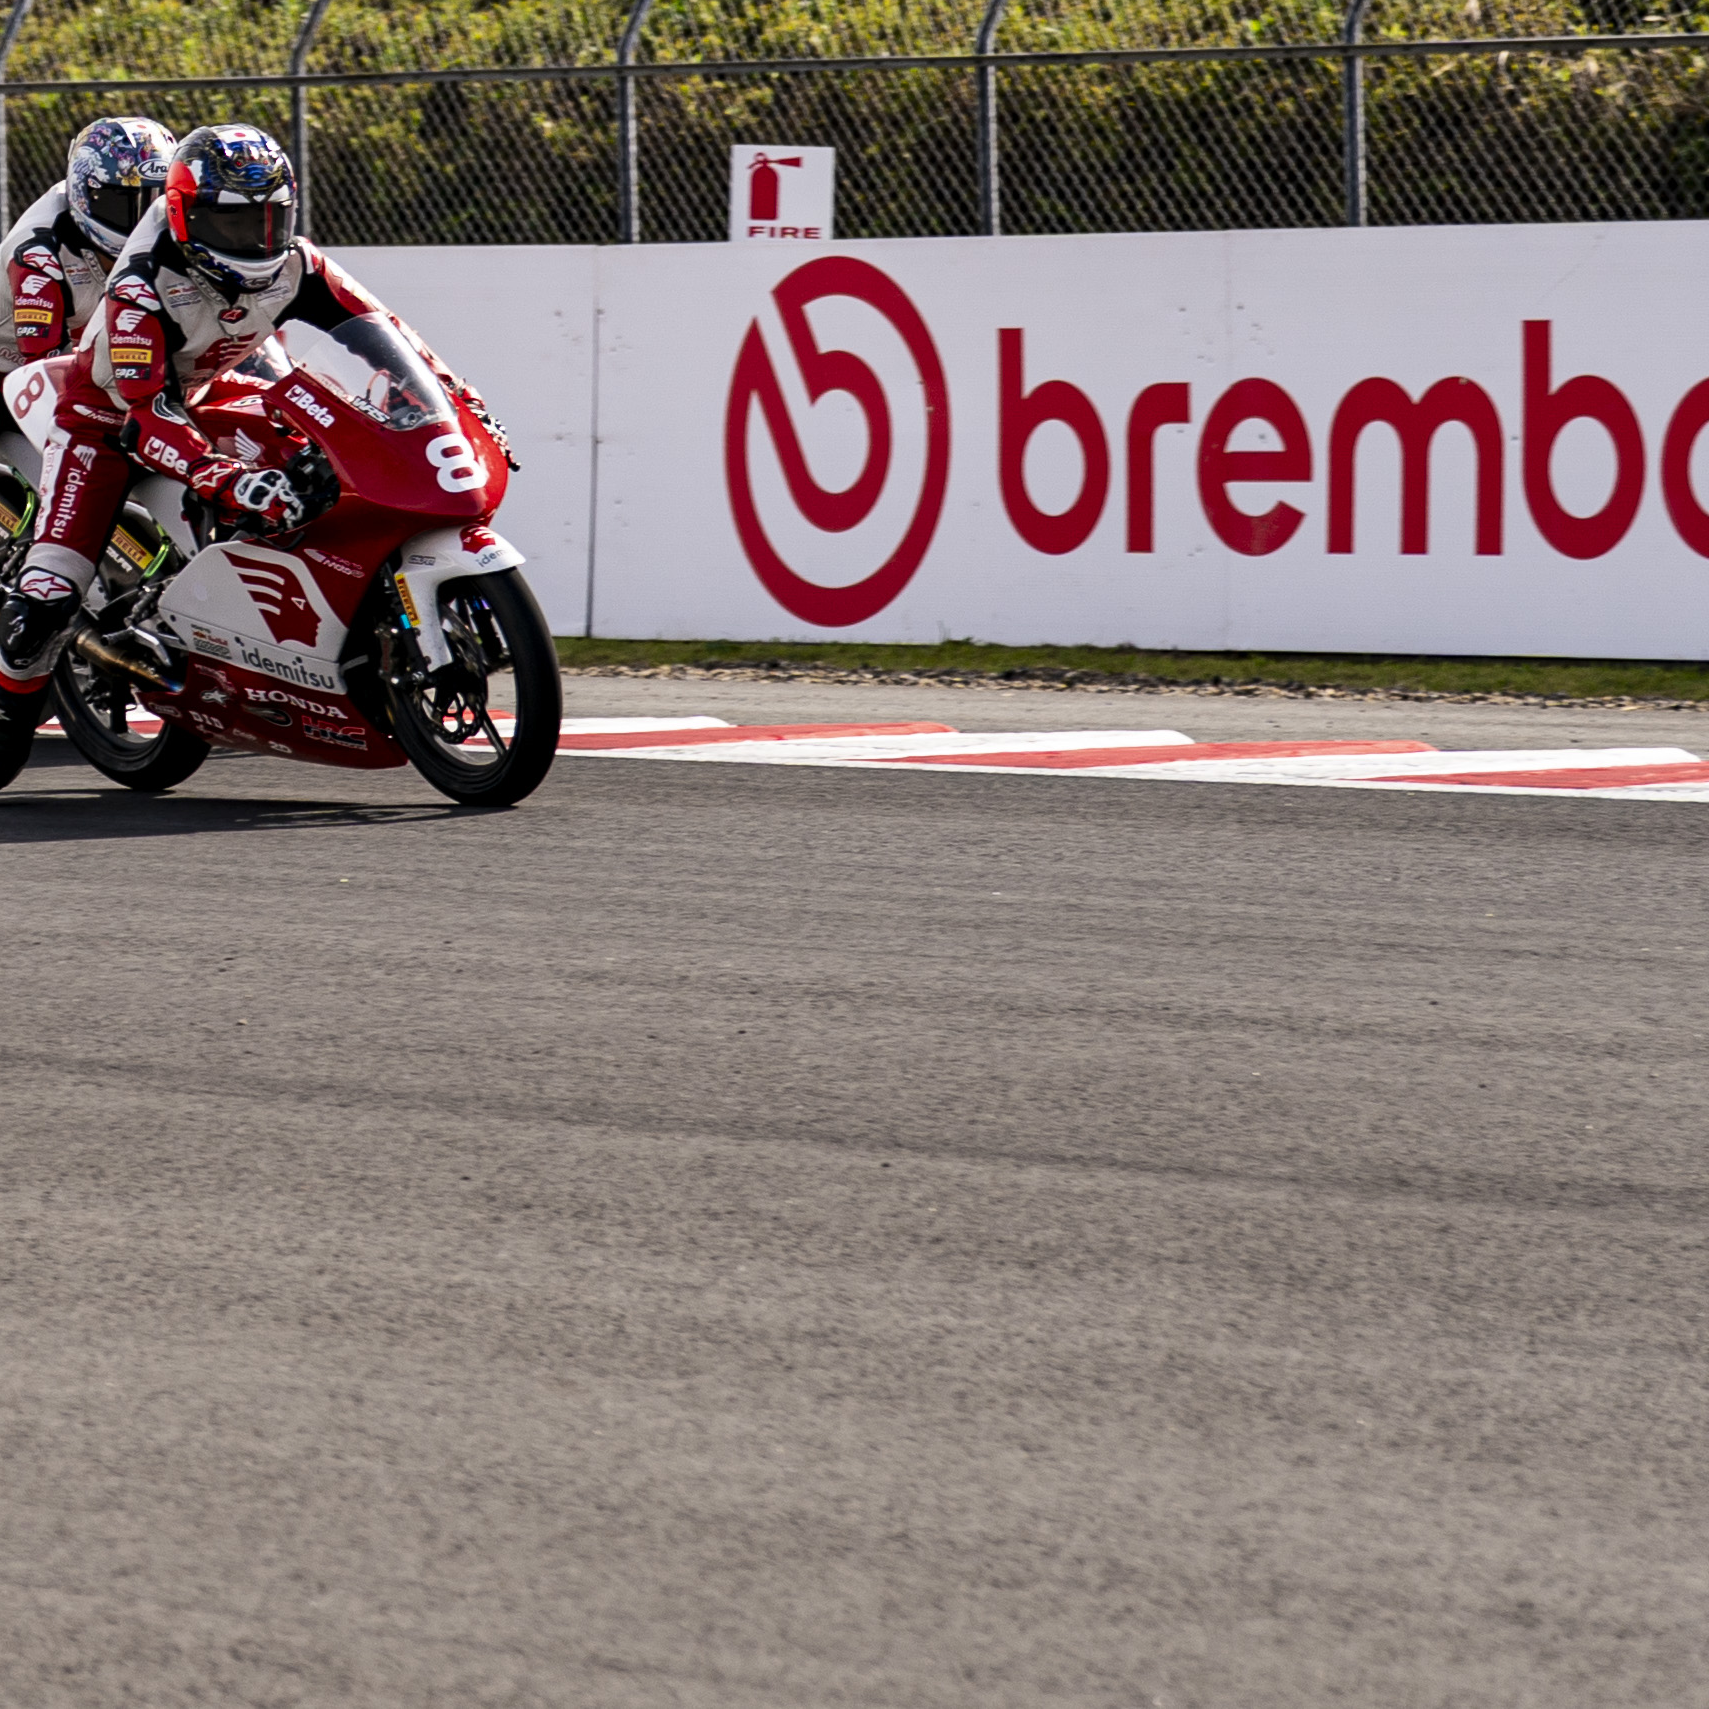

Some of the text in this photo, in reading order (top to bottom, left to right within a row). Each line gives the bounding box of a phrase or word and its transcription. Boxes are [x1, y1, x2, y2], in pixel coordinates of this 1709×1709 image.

[142, 161, 168, 175] Ara
[747, 226, 822, 239] FIRE
[14, 295, 54, 309] idemitsu
[110, 333, 153, 346] idemitsu
[12, 370, 45, 420] 8
[295, 391, 336, 429] Beta
[425, 432, 489, 494] 8
[50, 466, 88, 540] idemitsu
[241, 641, 335, 690] idemitsu
[244, 687, 349, 720] HONDA
